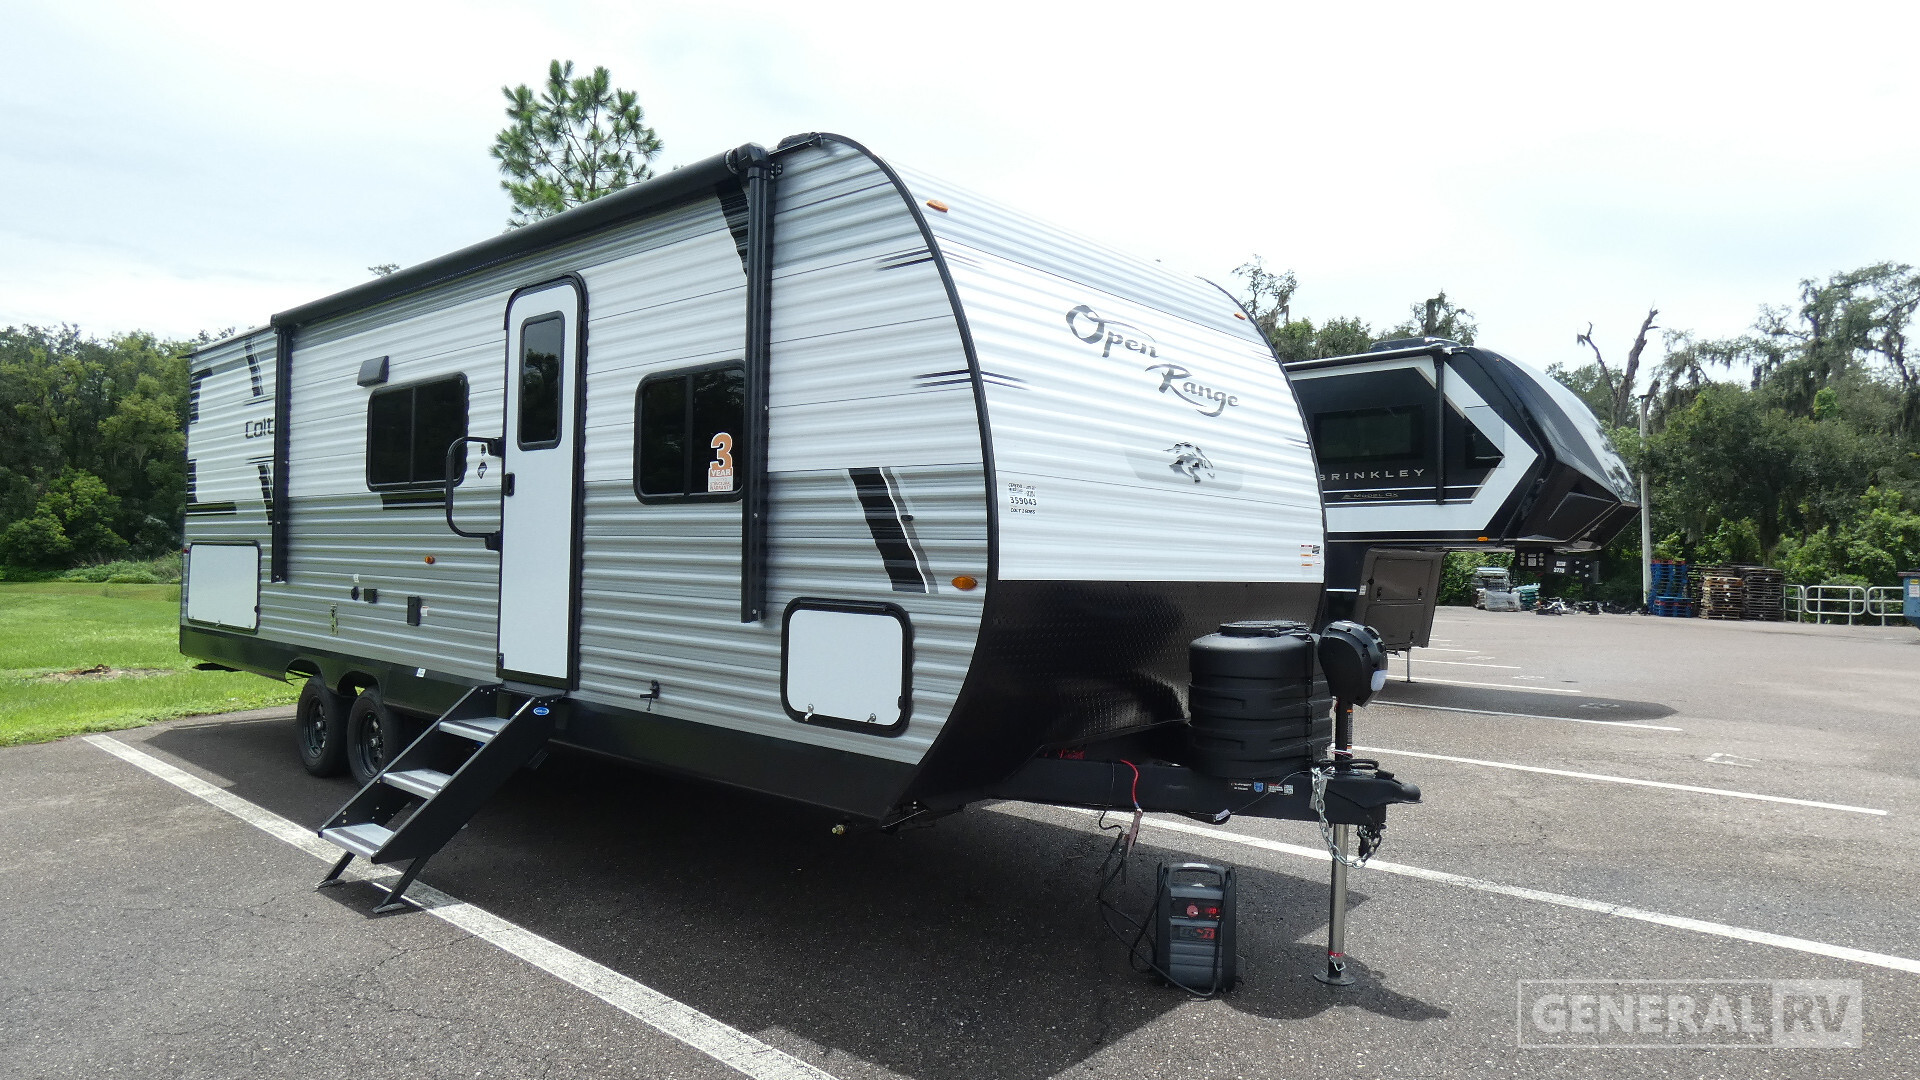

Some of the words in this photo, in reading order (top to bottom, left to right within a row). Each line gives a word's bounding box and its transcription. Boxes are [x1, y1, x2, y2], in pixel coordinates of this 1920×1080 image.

[1066, 304, 1159, 358] Open
[1145, 363, 1239, 418] Range
[245, 417, 275, 439] Colt
[710, 432, 733, 470] 3
[710, 469, 731, 477] YEAR
[1319, 468, 1425, 481] BRINKLEY
[1010, 496, 1037, 506] 359043
